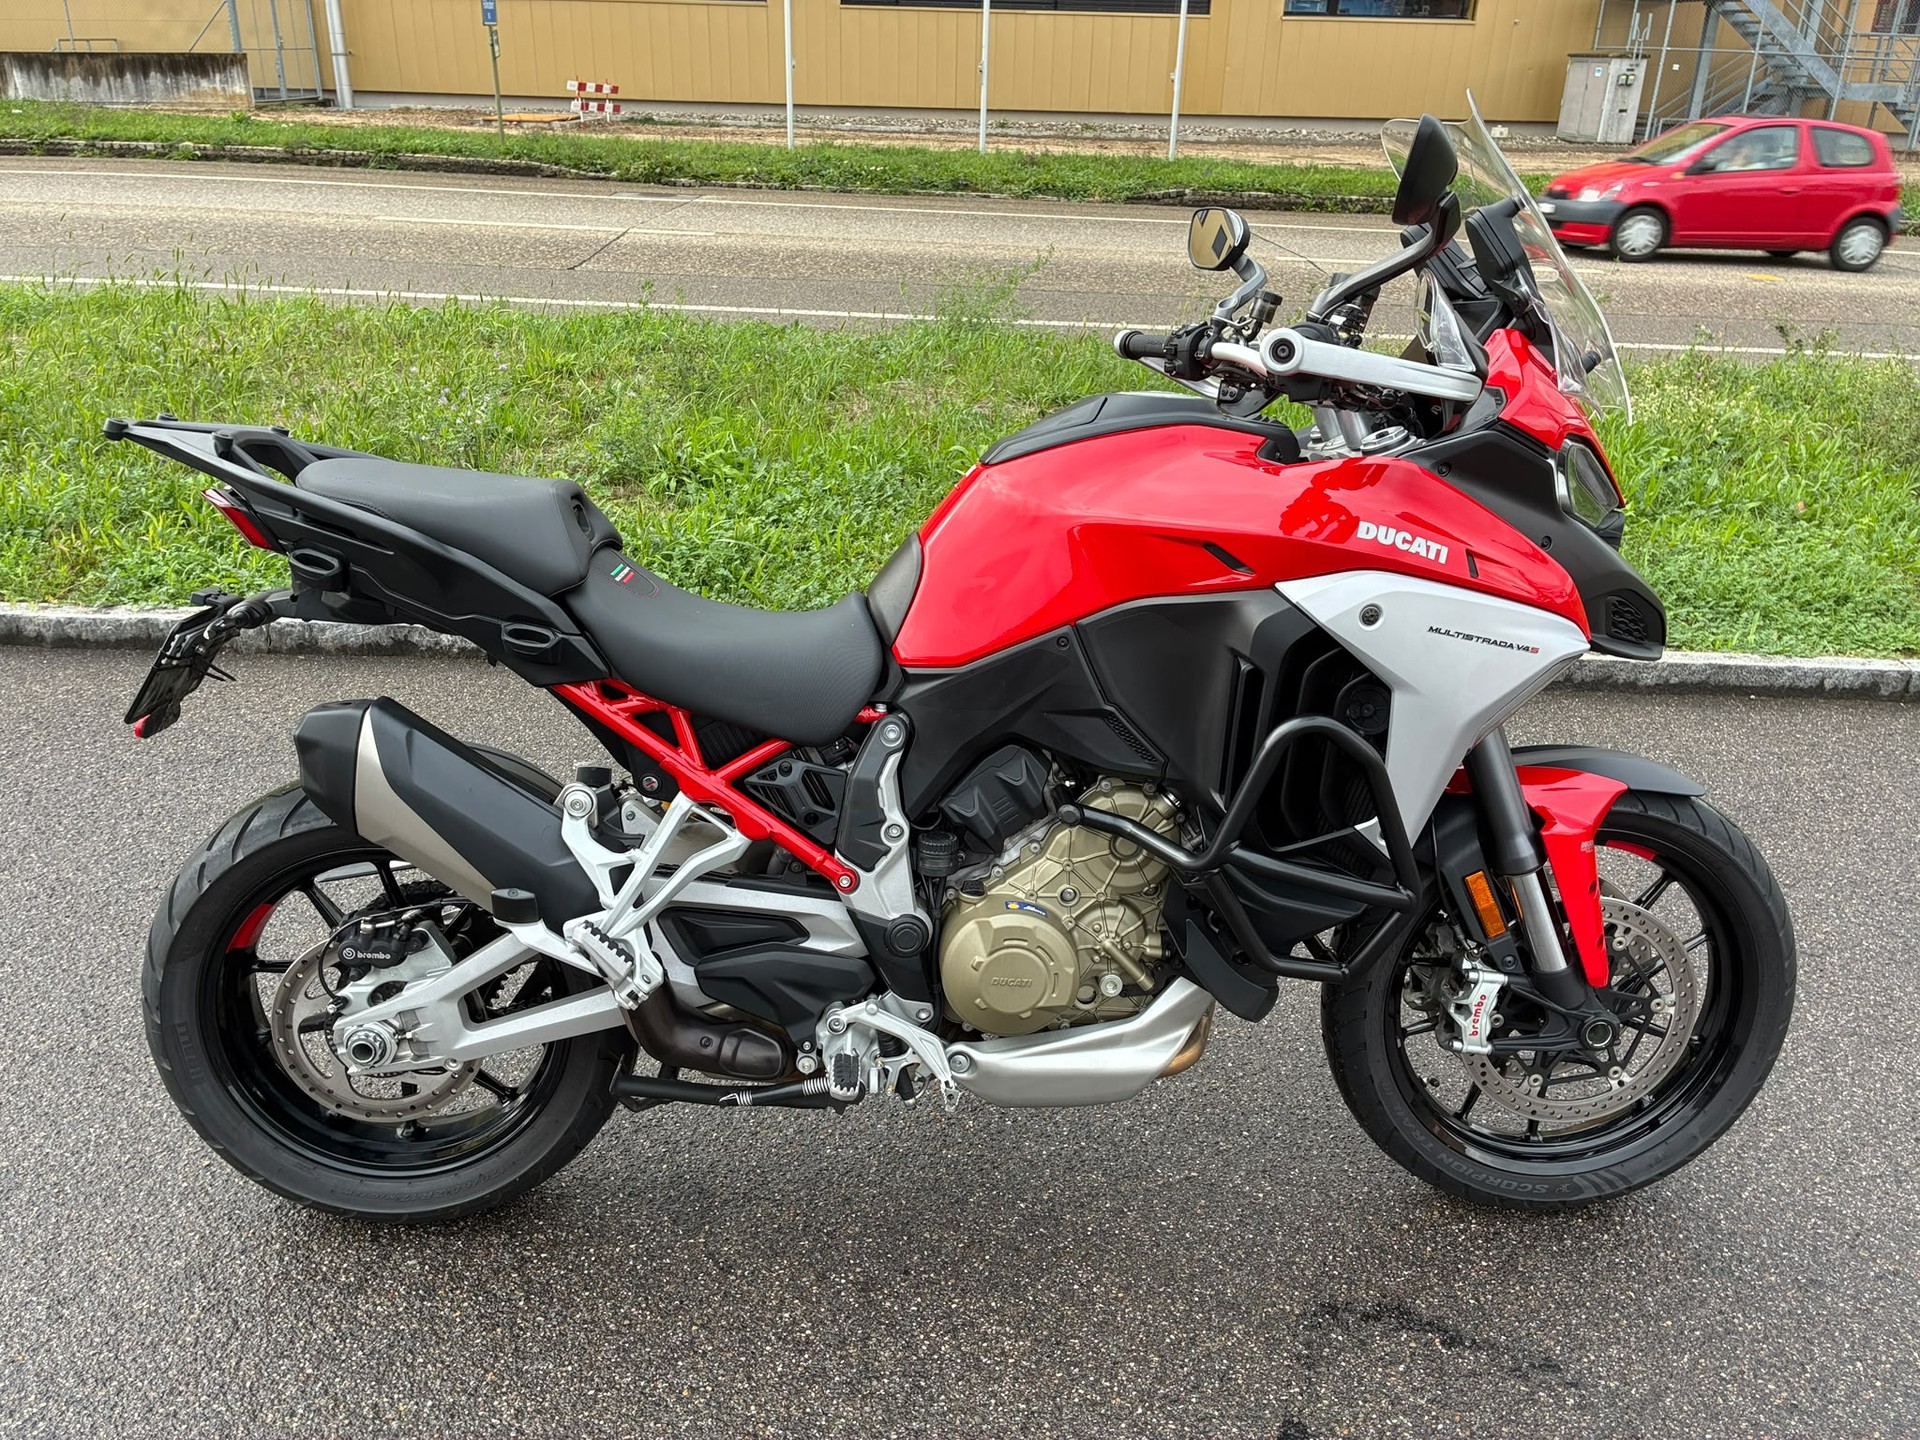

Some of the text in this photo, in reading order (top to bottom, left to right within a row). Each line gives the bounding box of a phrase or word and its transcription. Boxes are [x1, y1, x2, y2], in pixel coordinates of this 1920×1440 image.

[1356, 521, 1449, 564] DUCATI
[1427, 625, 1514, 649] MULTISTRADA
[357, 951, 391, 960] brembo
[990, 976, 1033, 988] DUCATI
[1469, 994, 1487, 1037] brembo
[1437, 1152, 1550, 1194] SCORPION
